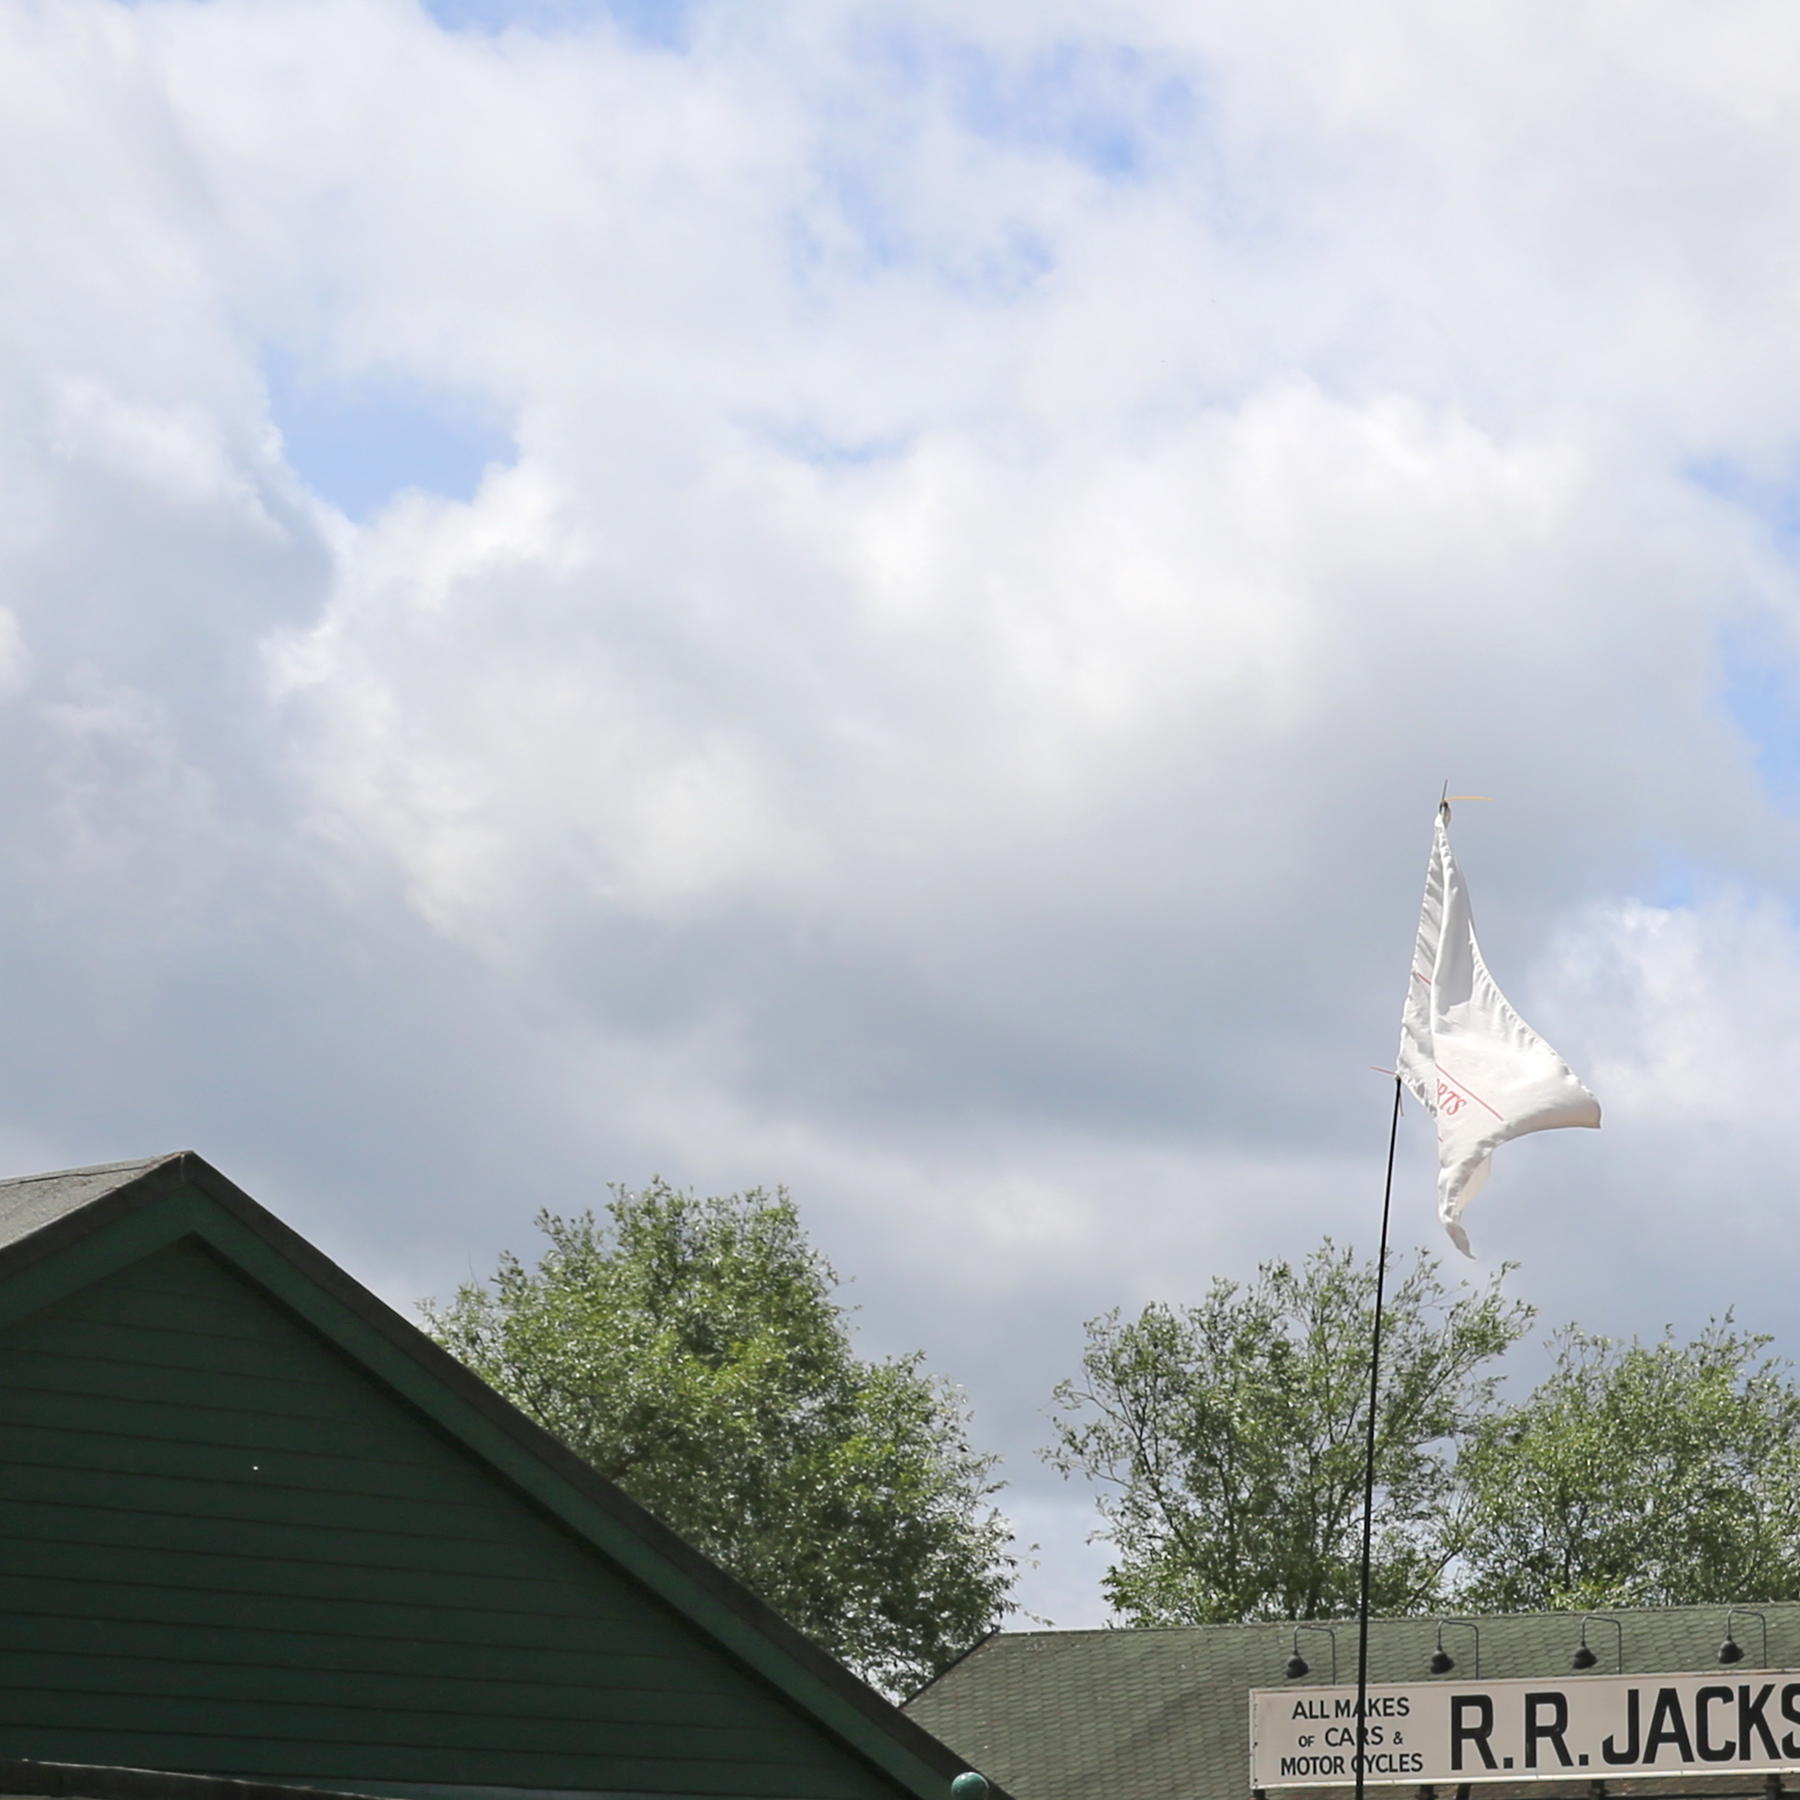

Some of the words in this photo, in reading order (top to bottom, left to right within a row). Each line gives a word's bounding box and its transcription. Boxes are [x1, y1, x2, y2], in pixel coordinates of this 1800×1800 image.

[1291, 1700, 1331, 1720] ALL
[1298, 1735, 1315, 1748] OF
[1392, 1730, 1404, 1745] &
[1280, 1754, 1346, 1777] MOTOR
